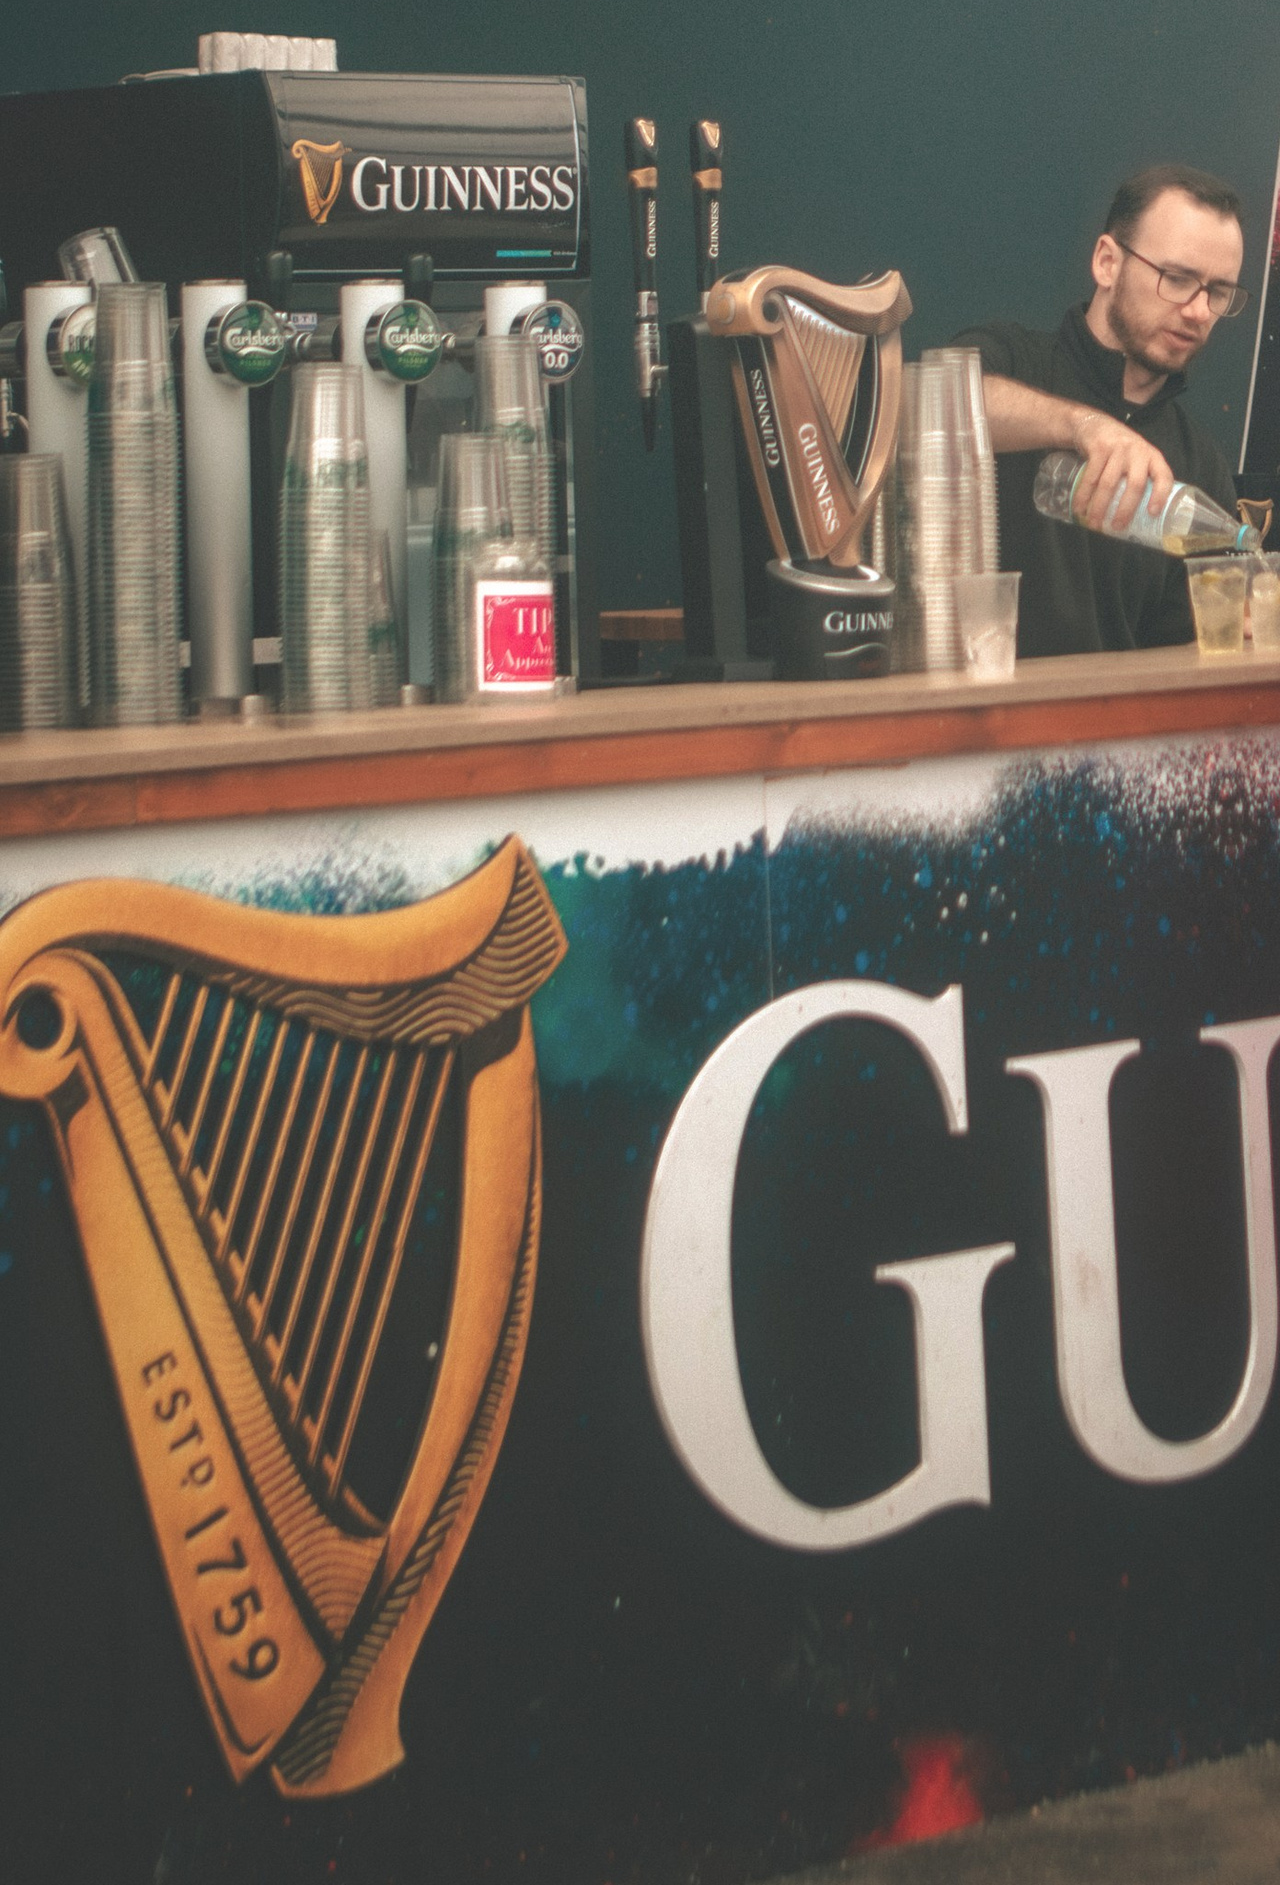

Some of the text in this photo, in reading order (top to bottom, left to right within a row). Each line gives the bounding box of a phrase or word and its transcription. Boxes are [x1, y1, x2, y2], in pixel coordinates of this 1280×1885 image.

[352, 156, 575, 212] GUINNESS
[647, 200, 657, 257] GUINNESS
[708, 201, 719, 258] GUINNESS
[225, 327, 284, 352] Carlsberg
[385, 325, 440, 351] Carlsberg
[545, 351, 569, 369] 0.0
[751, 368, 781, 467] GUINNESS
[798, 422, 840, 536] GUINNESS
[184, 1506, 280, 1681] 1759
